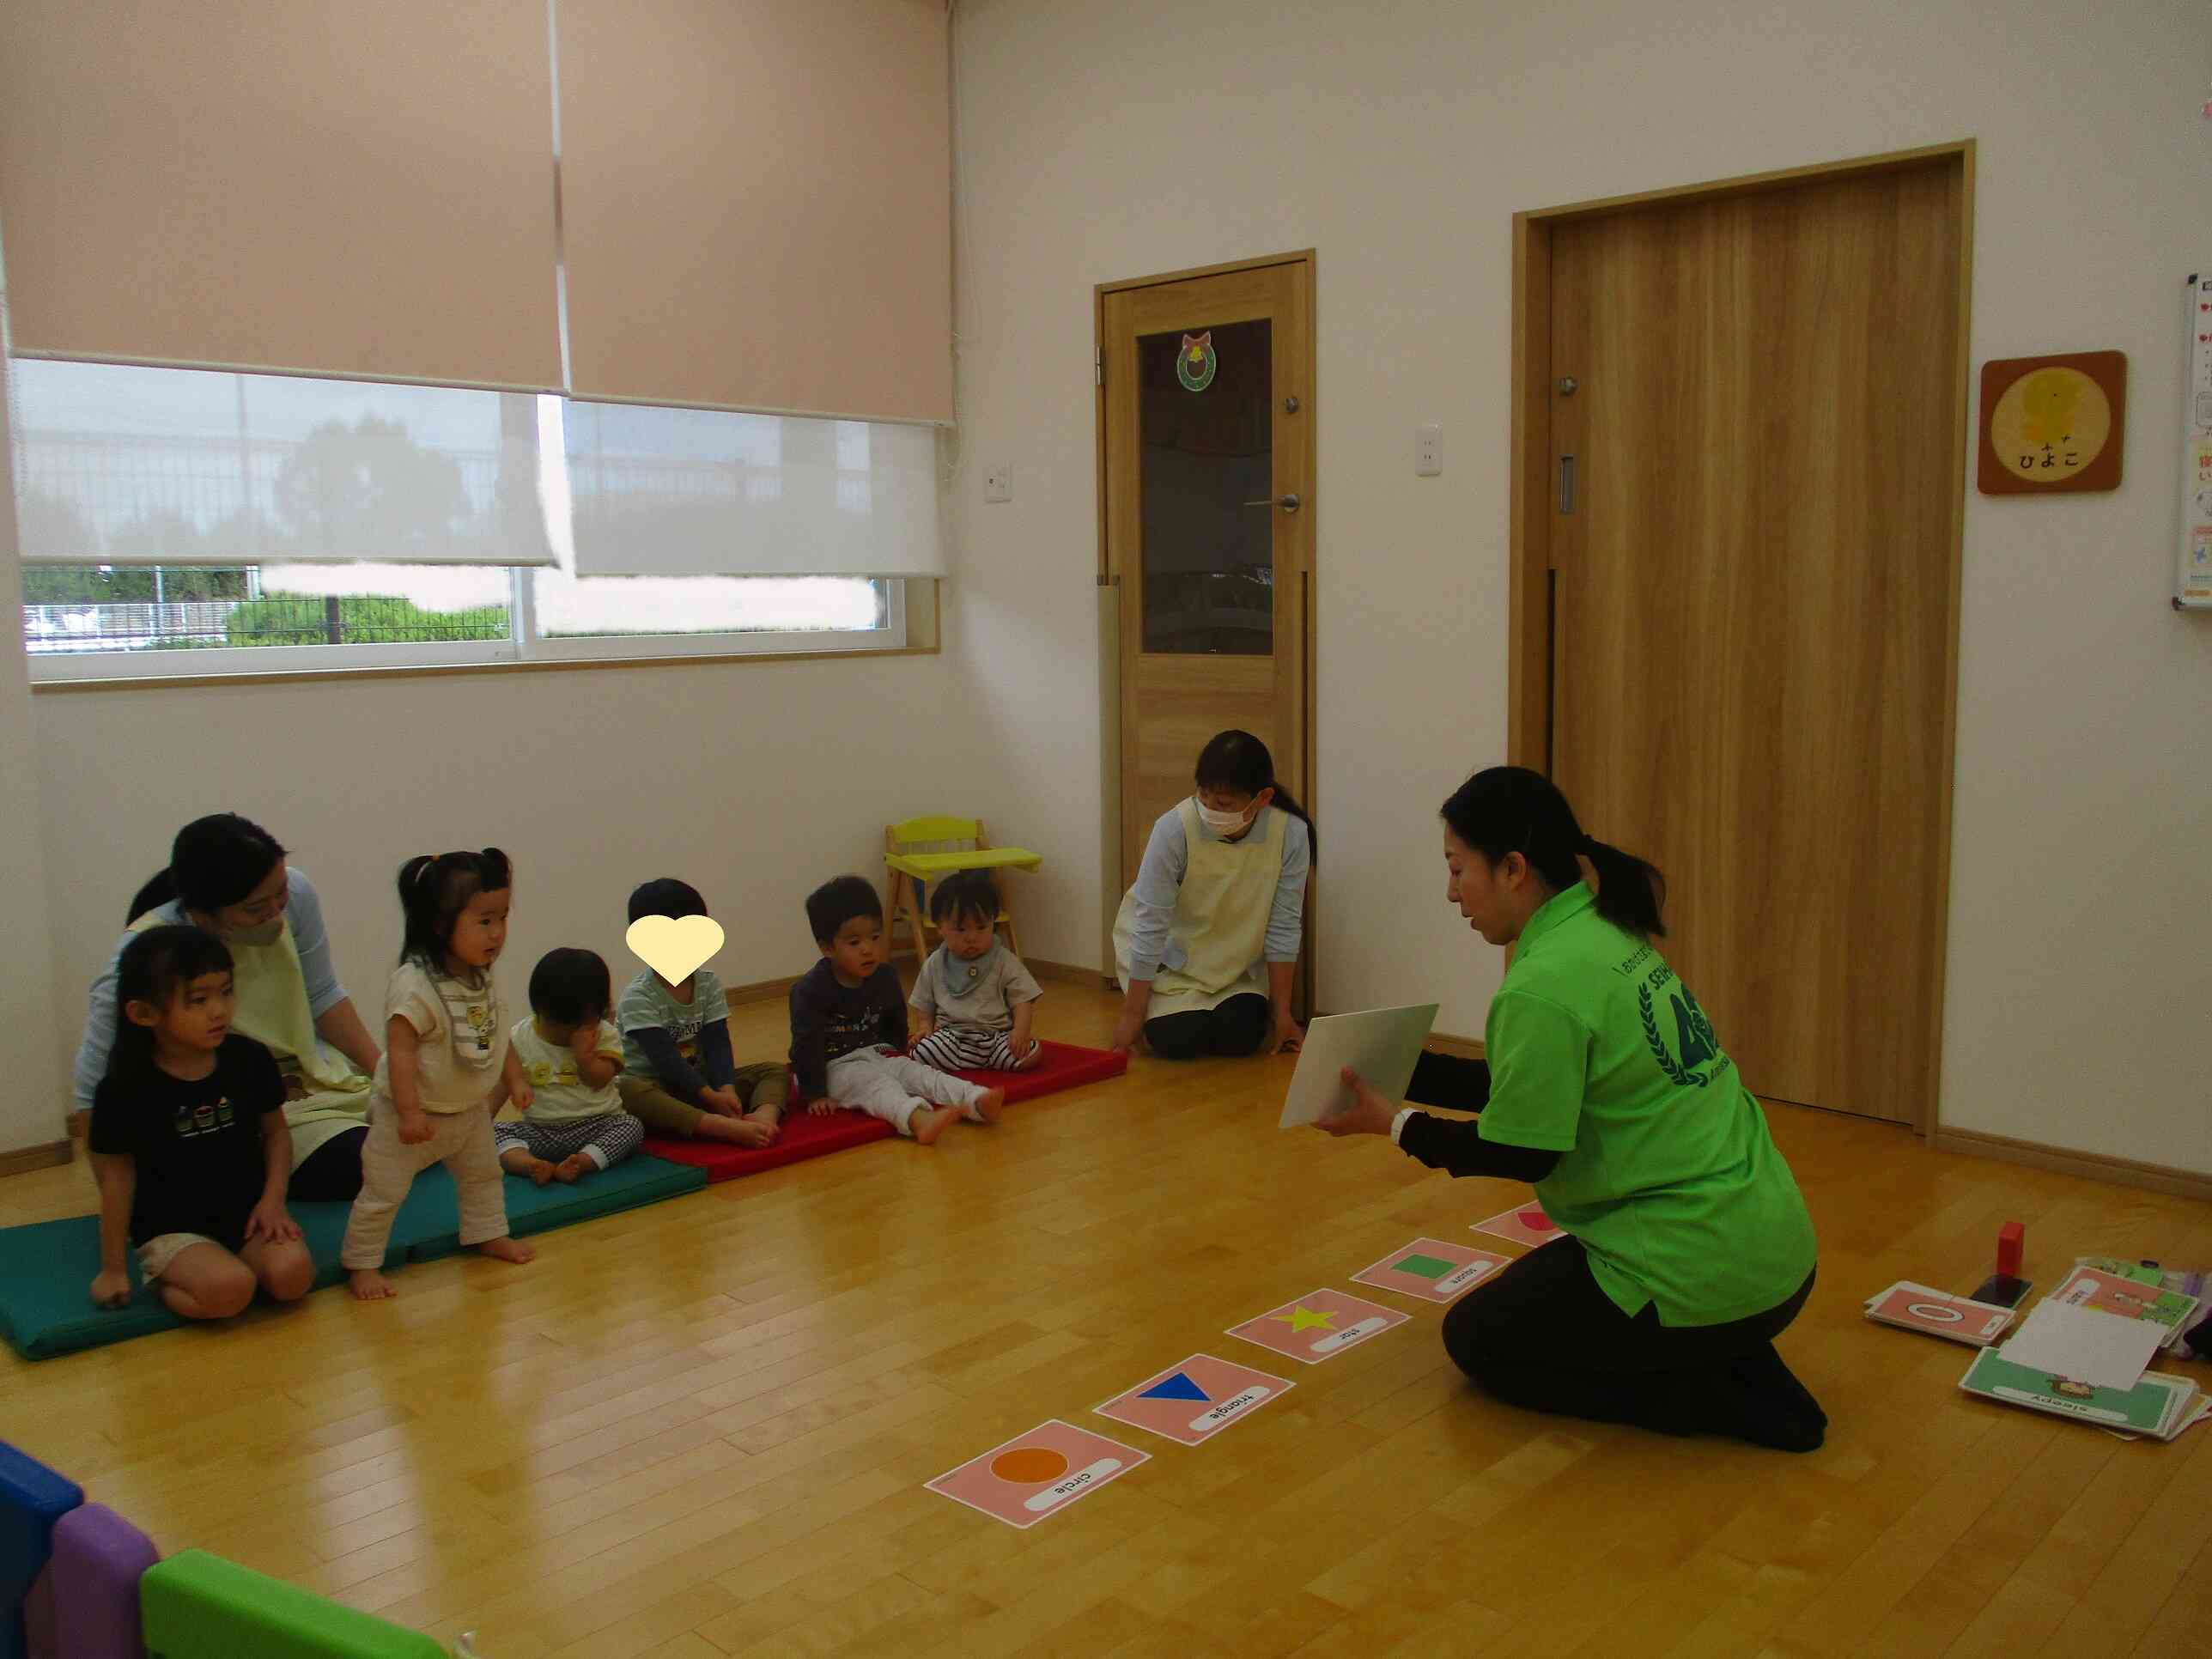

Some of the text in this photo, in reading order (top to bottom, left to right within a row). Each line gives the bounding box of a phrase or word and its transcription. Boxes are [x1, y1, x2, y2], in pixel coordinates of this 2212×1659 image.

[2019, 452, 2079, 470] ひよこ
[1208, 1393, 1254, 1420] triangle
[1054, 1472, 1091, 1495] circle
